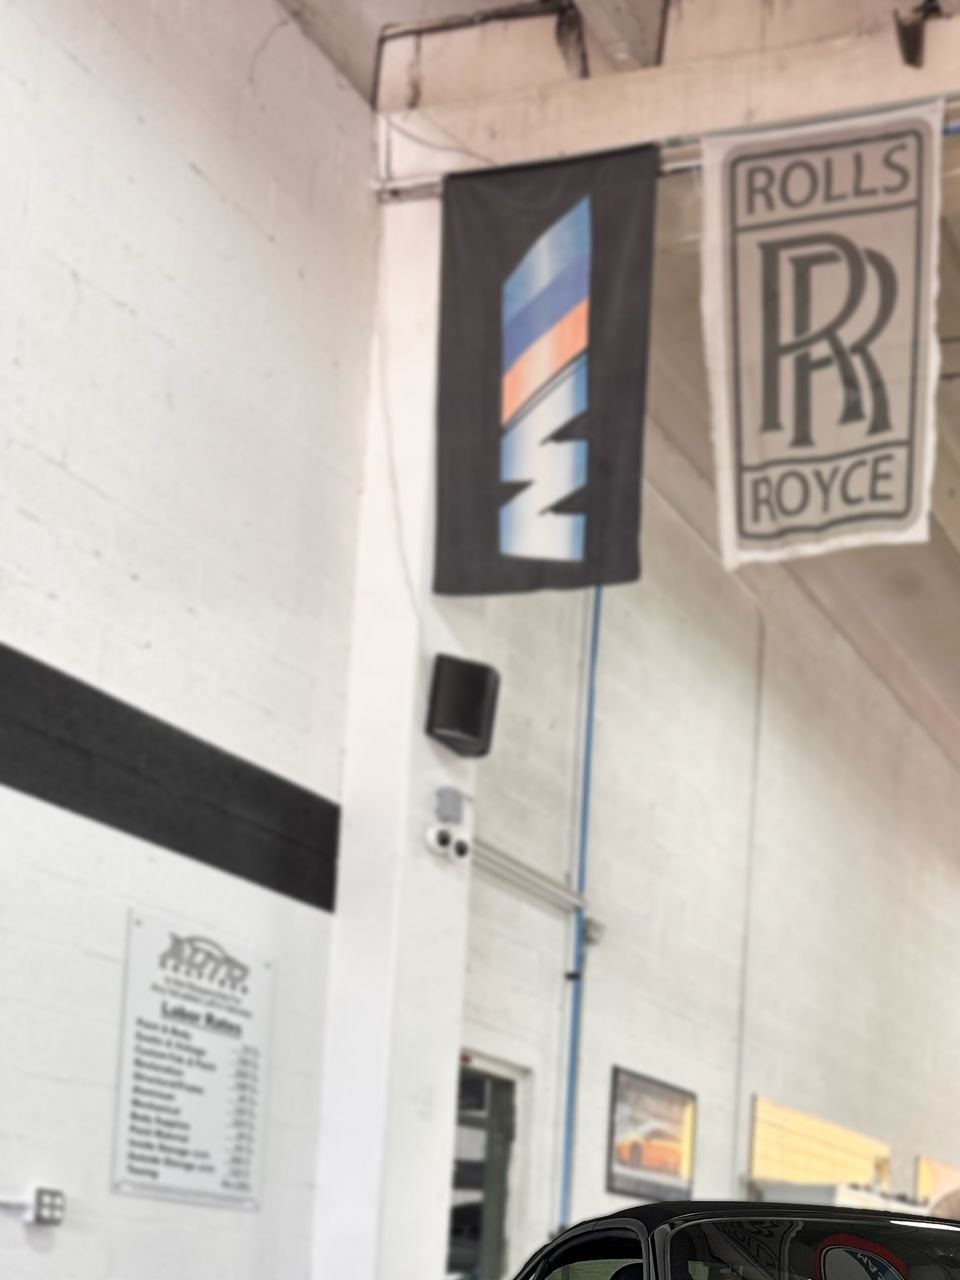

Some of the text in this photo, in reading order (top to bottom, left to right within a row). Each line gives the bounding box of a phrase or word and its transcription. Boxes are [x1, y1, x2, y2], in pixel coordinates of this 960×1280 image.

[745, 143, 911, 215] ROLLS
[751, 454, 895, 524] ROYCE
[161, 1000, 200, 1024] Labor
[205, 1012, 242, 1034] Rates
